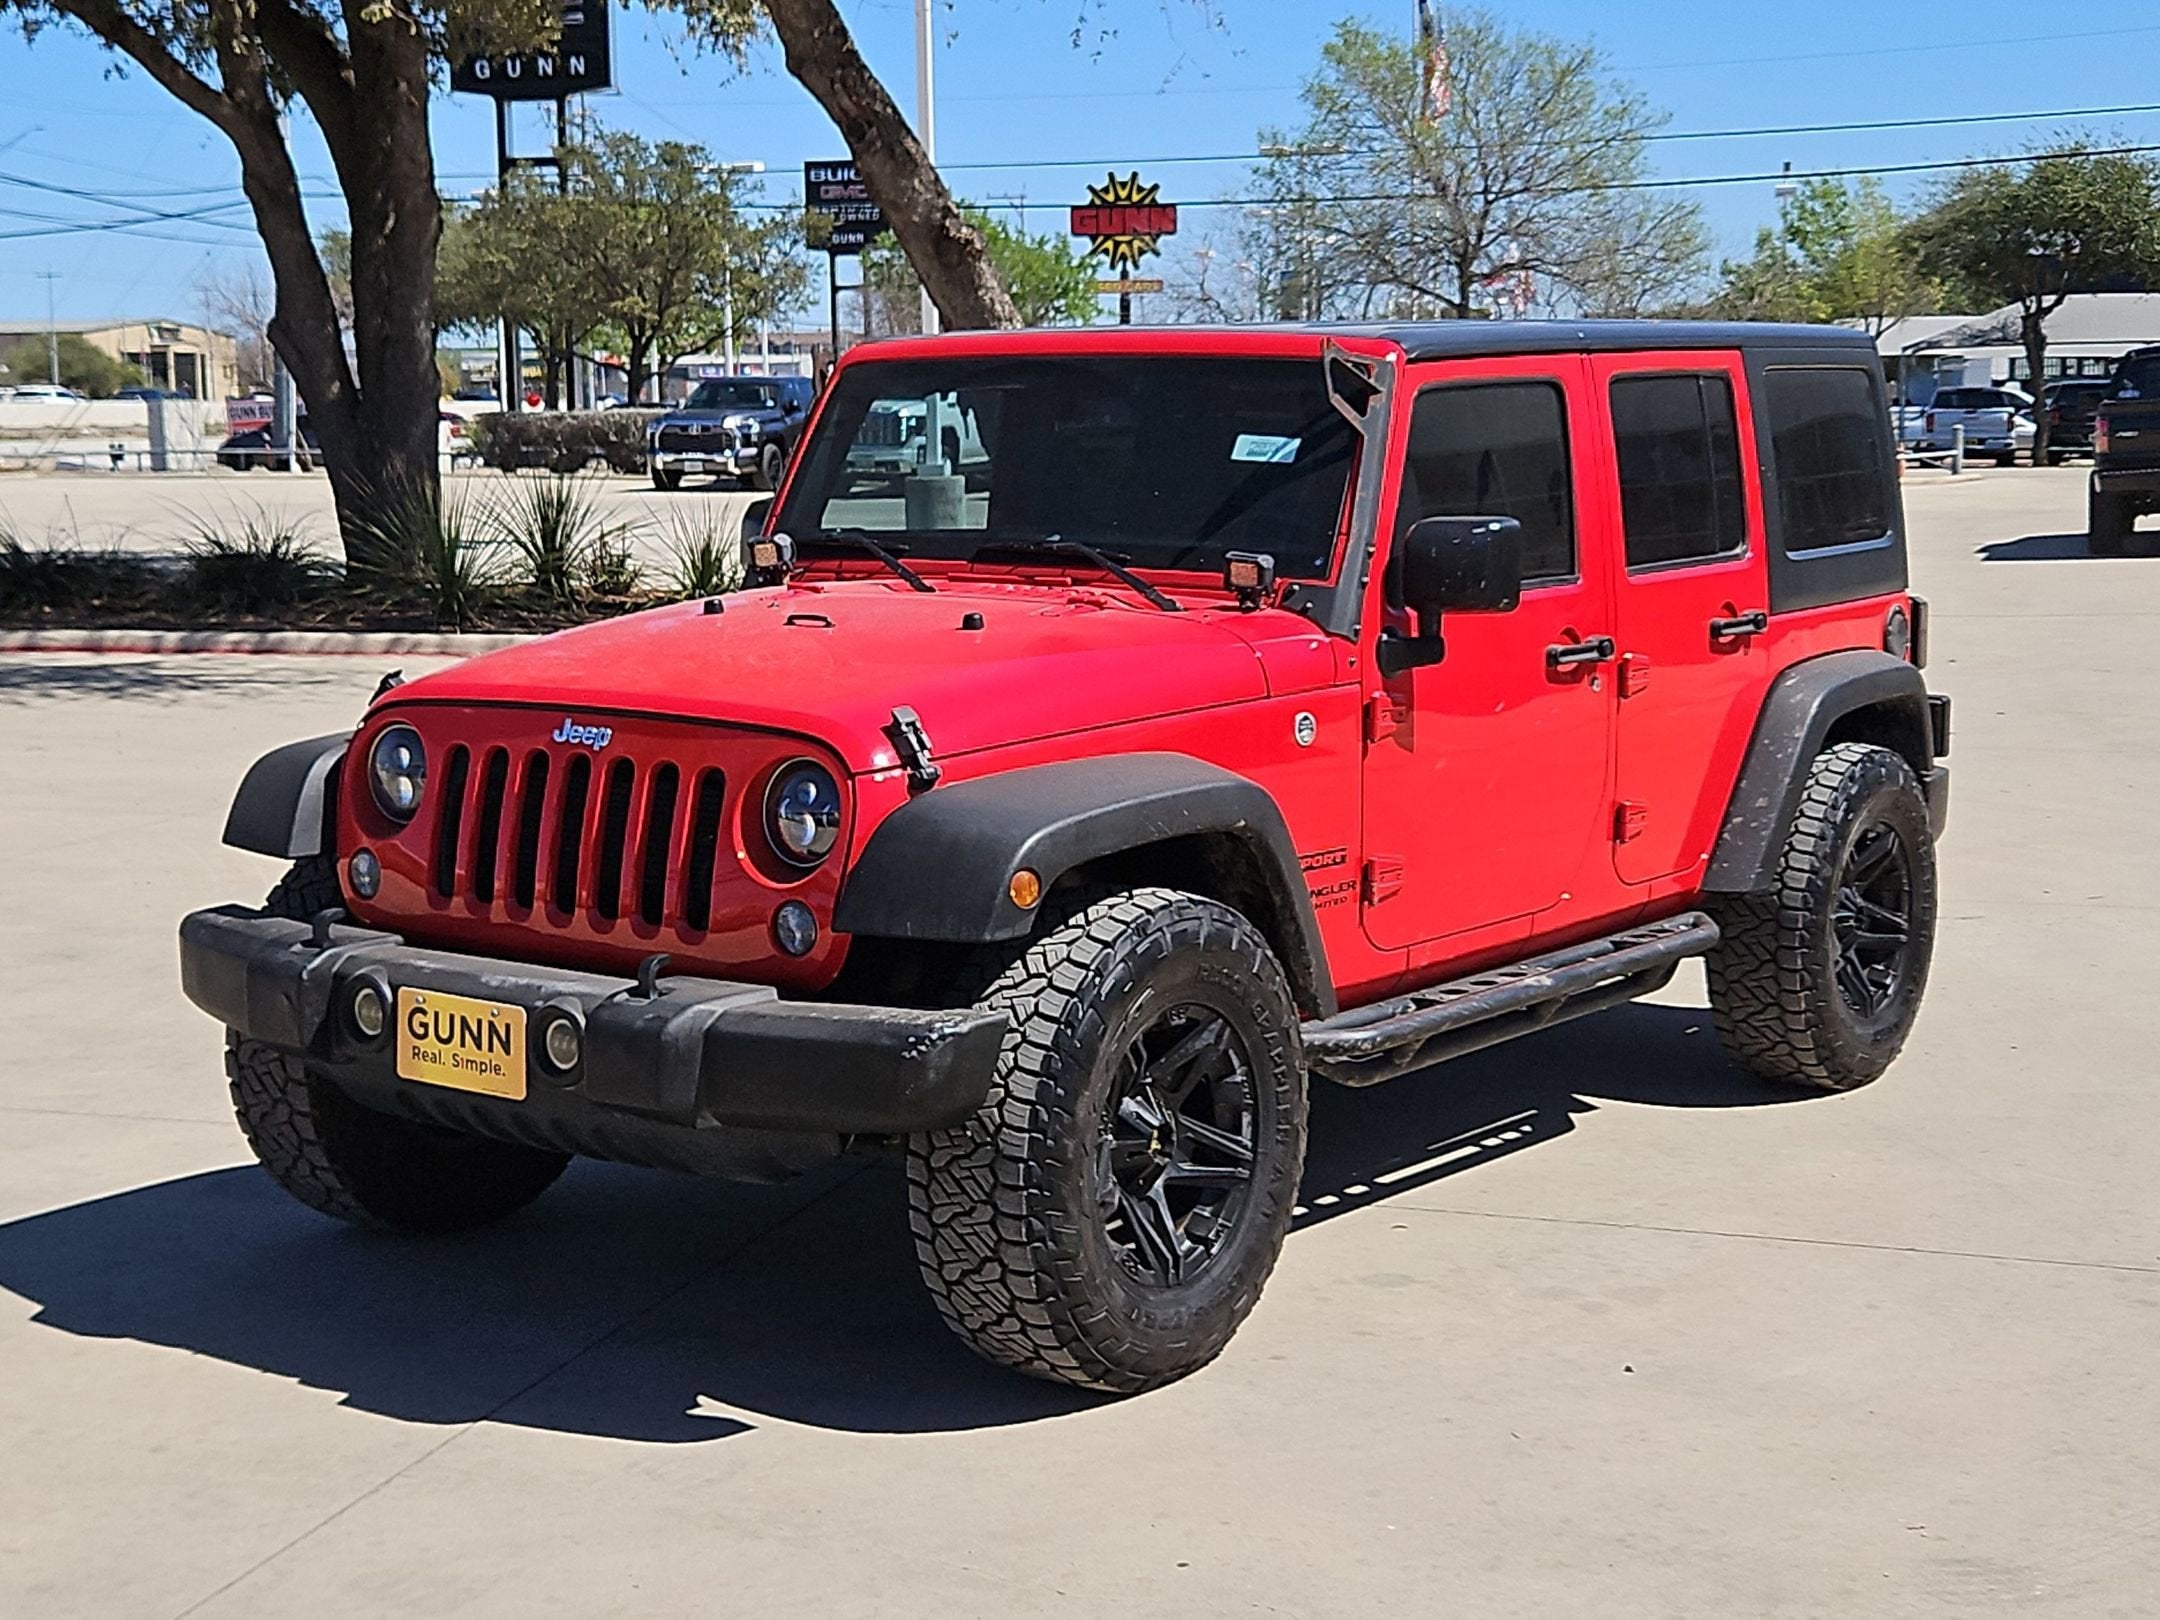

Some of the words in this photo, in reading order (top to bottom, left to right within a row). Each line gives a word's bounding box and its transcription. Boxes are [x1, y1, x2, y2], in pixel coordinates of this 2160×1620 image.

[474, 54, 586, 80] GUNN
[809, 166, 864, 182] BUIC
[1071, 206, 1176, 235] GUNN
[553, 718, 613, 751] Jeep
[1299, 849, 1347, 871] PORT
[1309, 879, 1357, 899] NGLER
[1314, 896, 1348, 910] MITED
[407, 1006, 511, 1056] GUNN
[412, 1045, 446, 1066] Real.
[452, 1052, 506, 1077] Simple.
